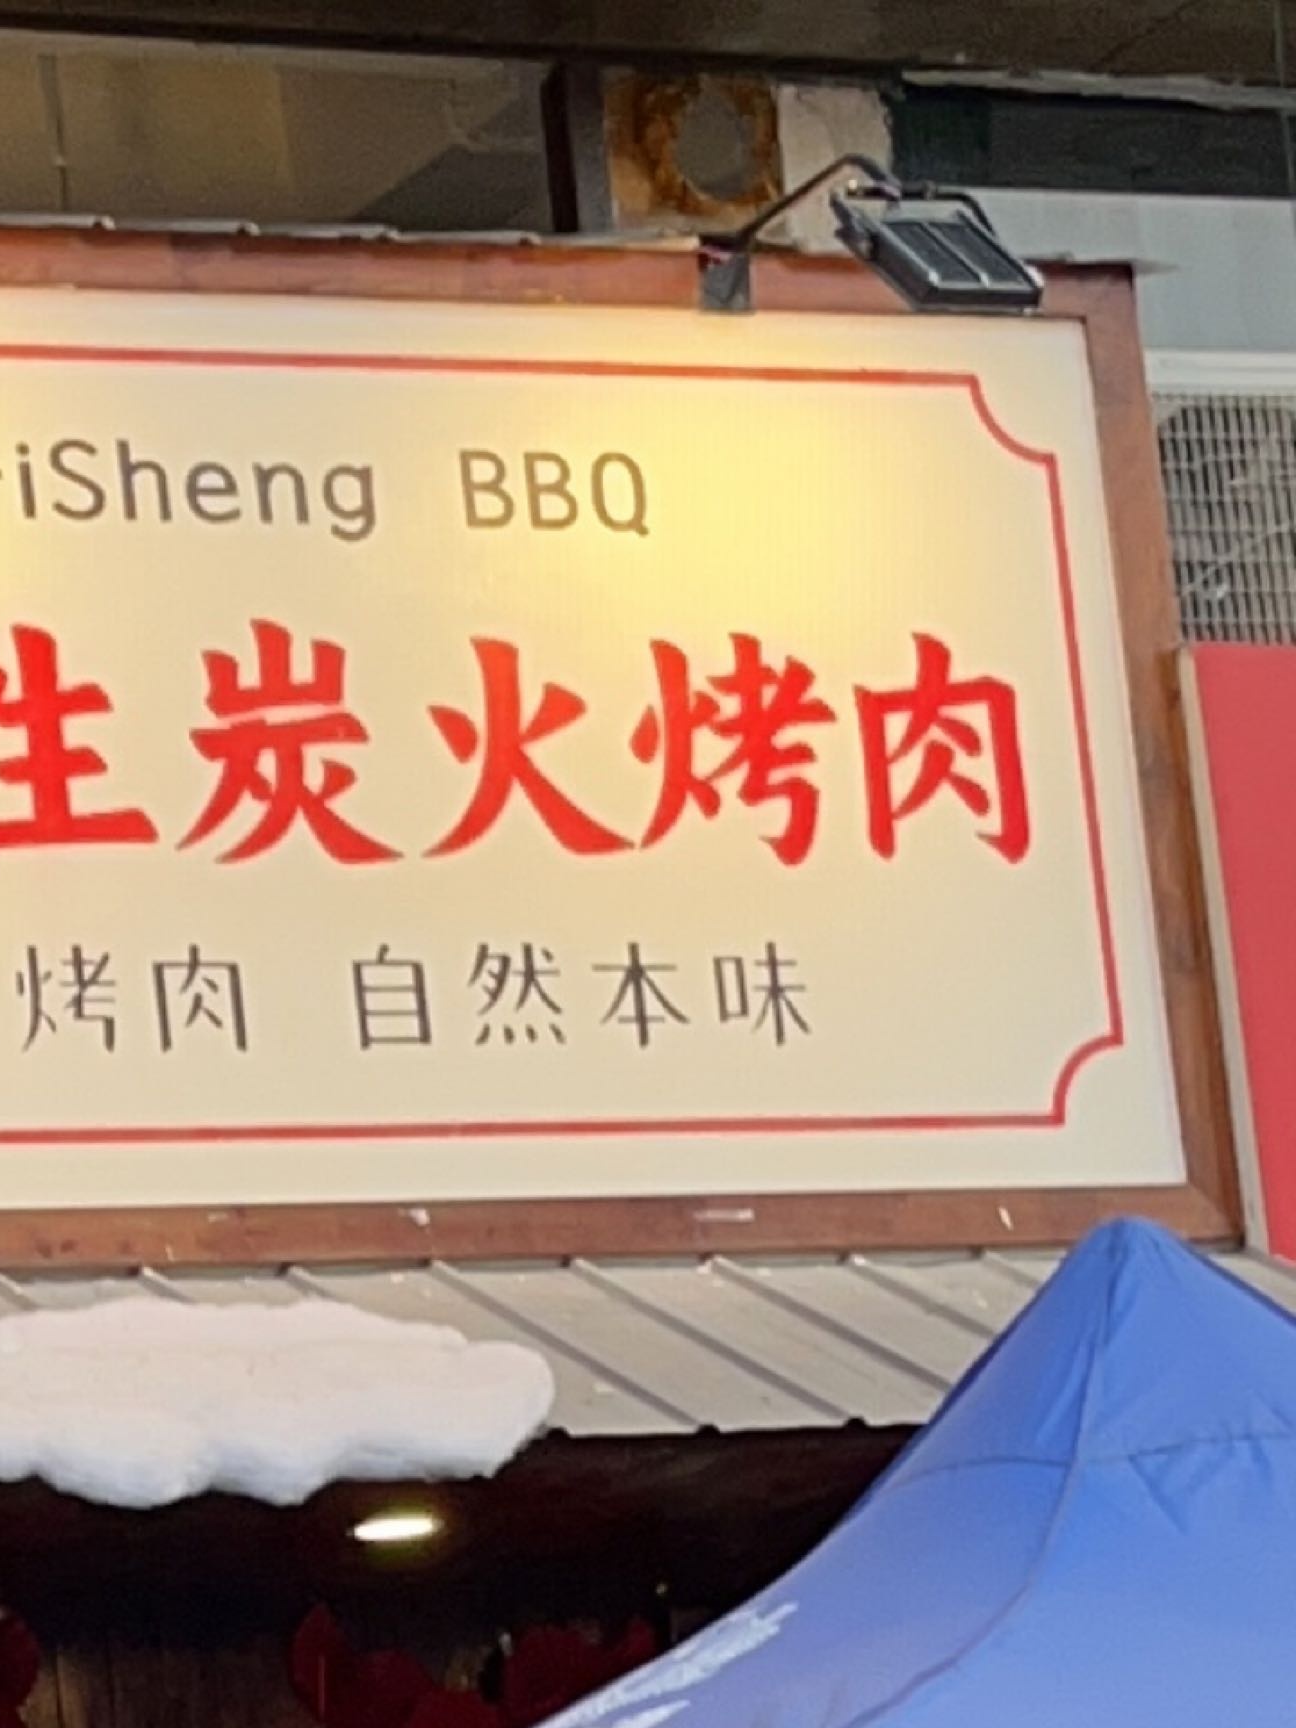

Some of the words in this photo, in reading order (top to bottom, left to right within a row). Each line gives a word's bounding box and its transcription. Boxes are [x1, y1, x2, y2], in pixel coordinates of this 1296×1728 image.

[460, 450, 652, 538] BBQ
[352, 942, 814, 1052] 自然本味
